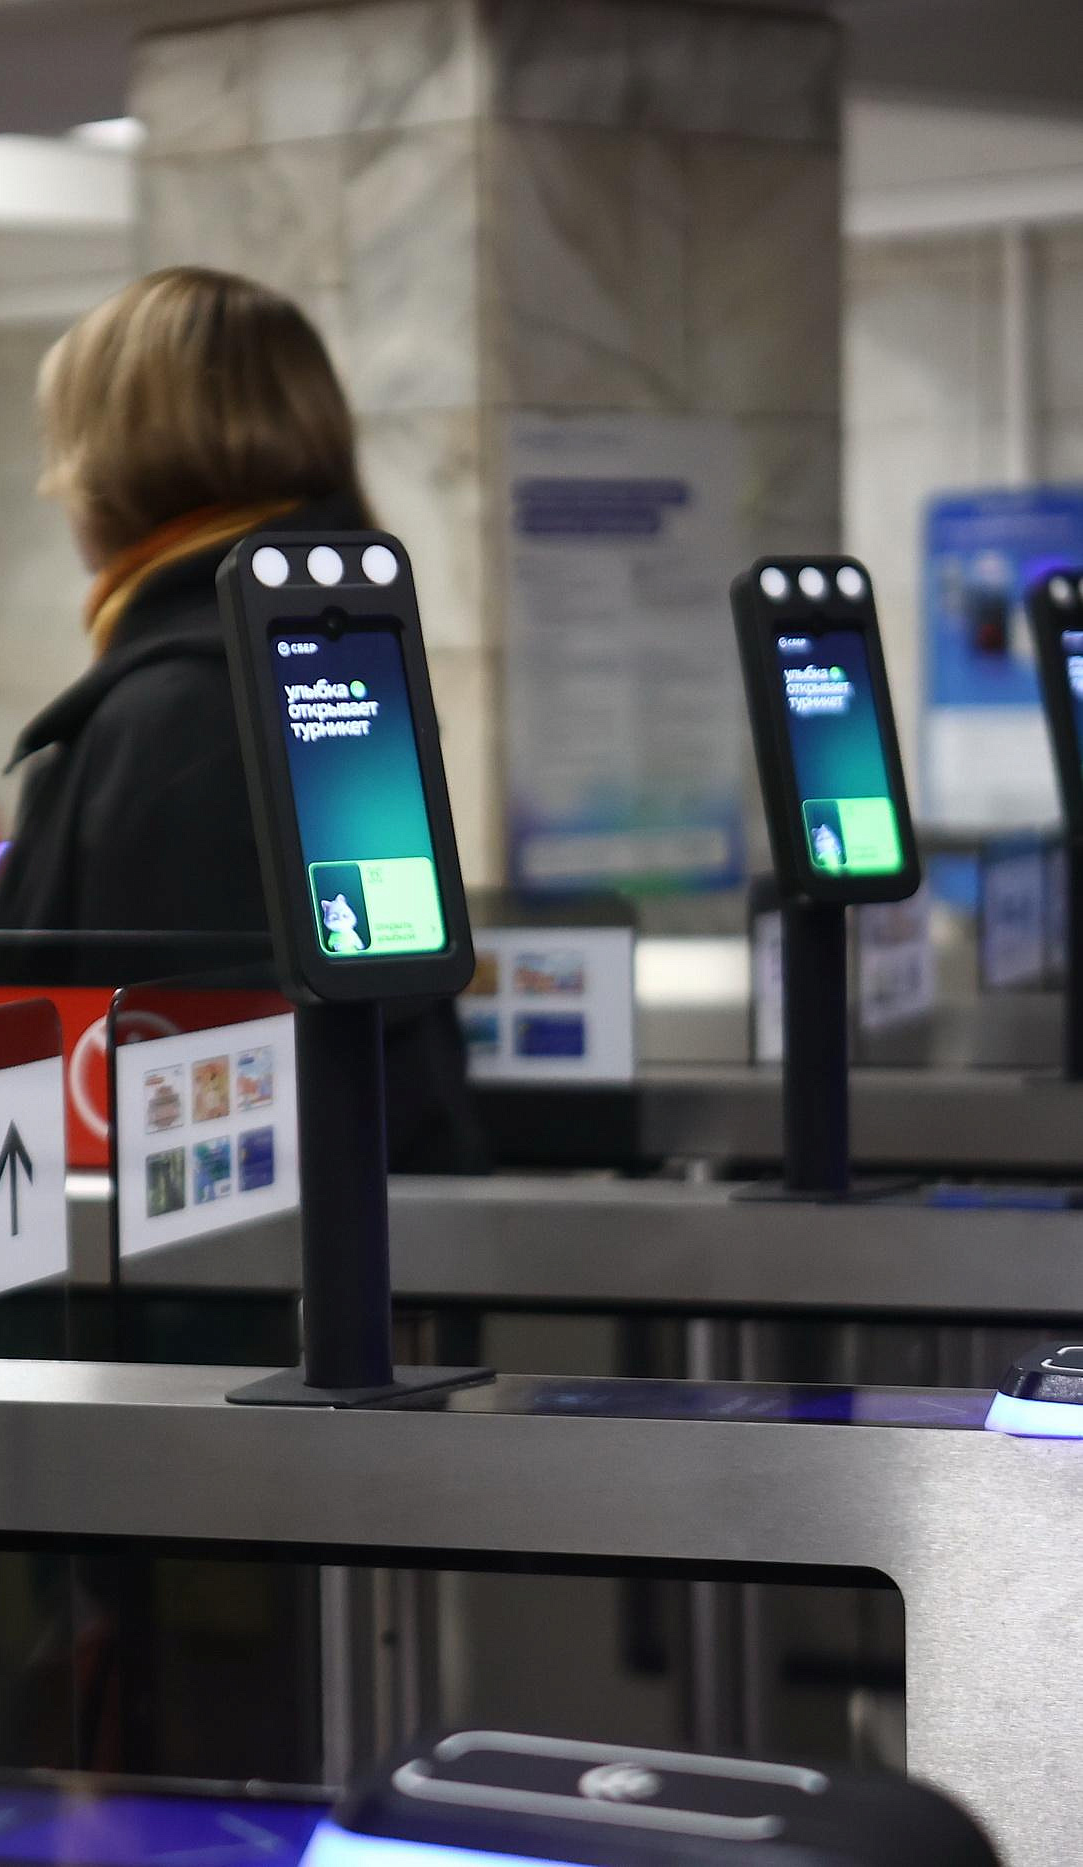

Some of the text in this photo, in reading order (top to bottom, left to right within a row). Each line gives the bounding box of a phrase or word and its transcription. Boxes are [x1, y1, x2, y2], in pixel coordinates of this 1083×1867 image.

[284, 678, 350, 705] улыбка
[287, 700, 380, 722] открывает
[289, 720, 372, 743] турникет
